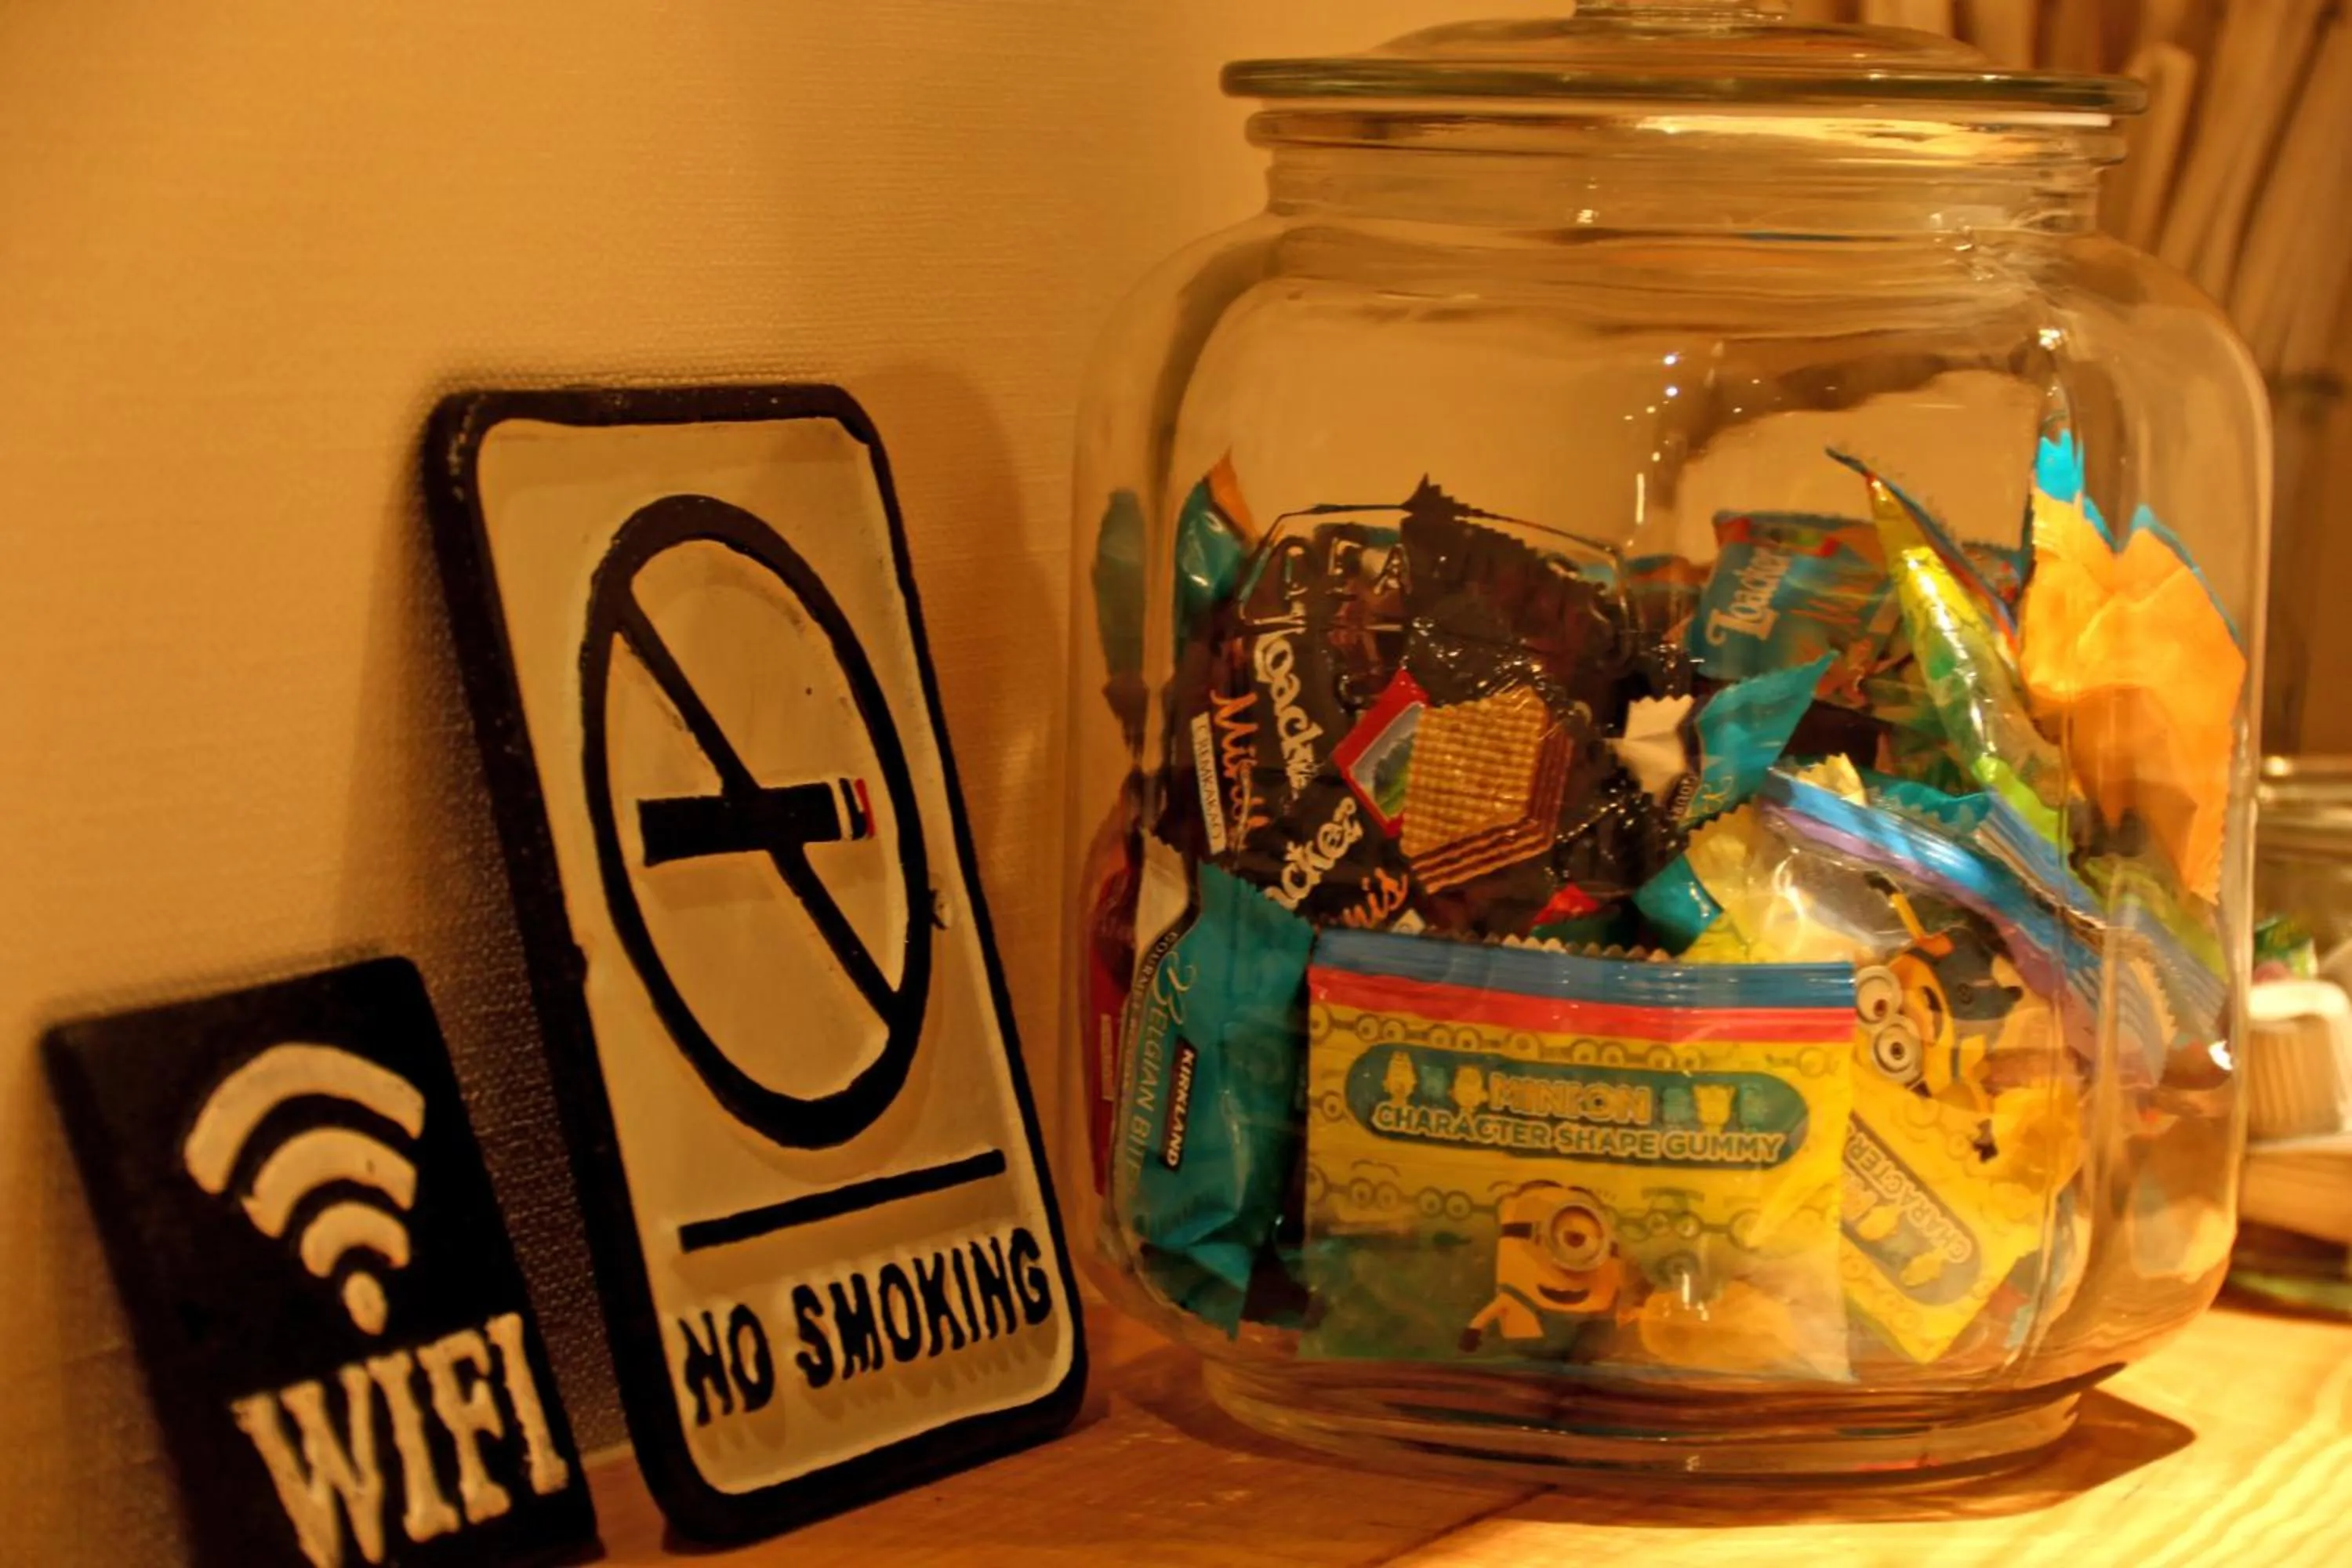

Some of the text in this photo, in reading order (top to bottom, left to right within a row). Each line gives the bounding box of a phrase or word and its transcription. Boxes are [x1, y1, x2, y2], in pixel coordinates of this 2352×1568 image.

[1254, 626, 1323, 792] Loack
[1166, 1048, 1196, 1167] KIRKLAND
[1374, 1102, 1786, 1163] CHARACTER SHAPE GUMMY
[1846, 1133, 1972, 1263] CHARACTER
[677, 1226, 1053, 1427] NO SMOKING
[230, 1312, 568, 1567] WIFI
